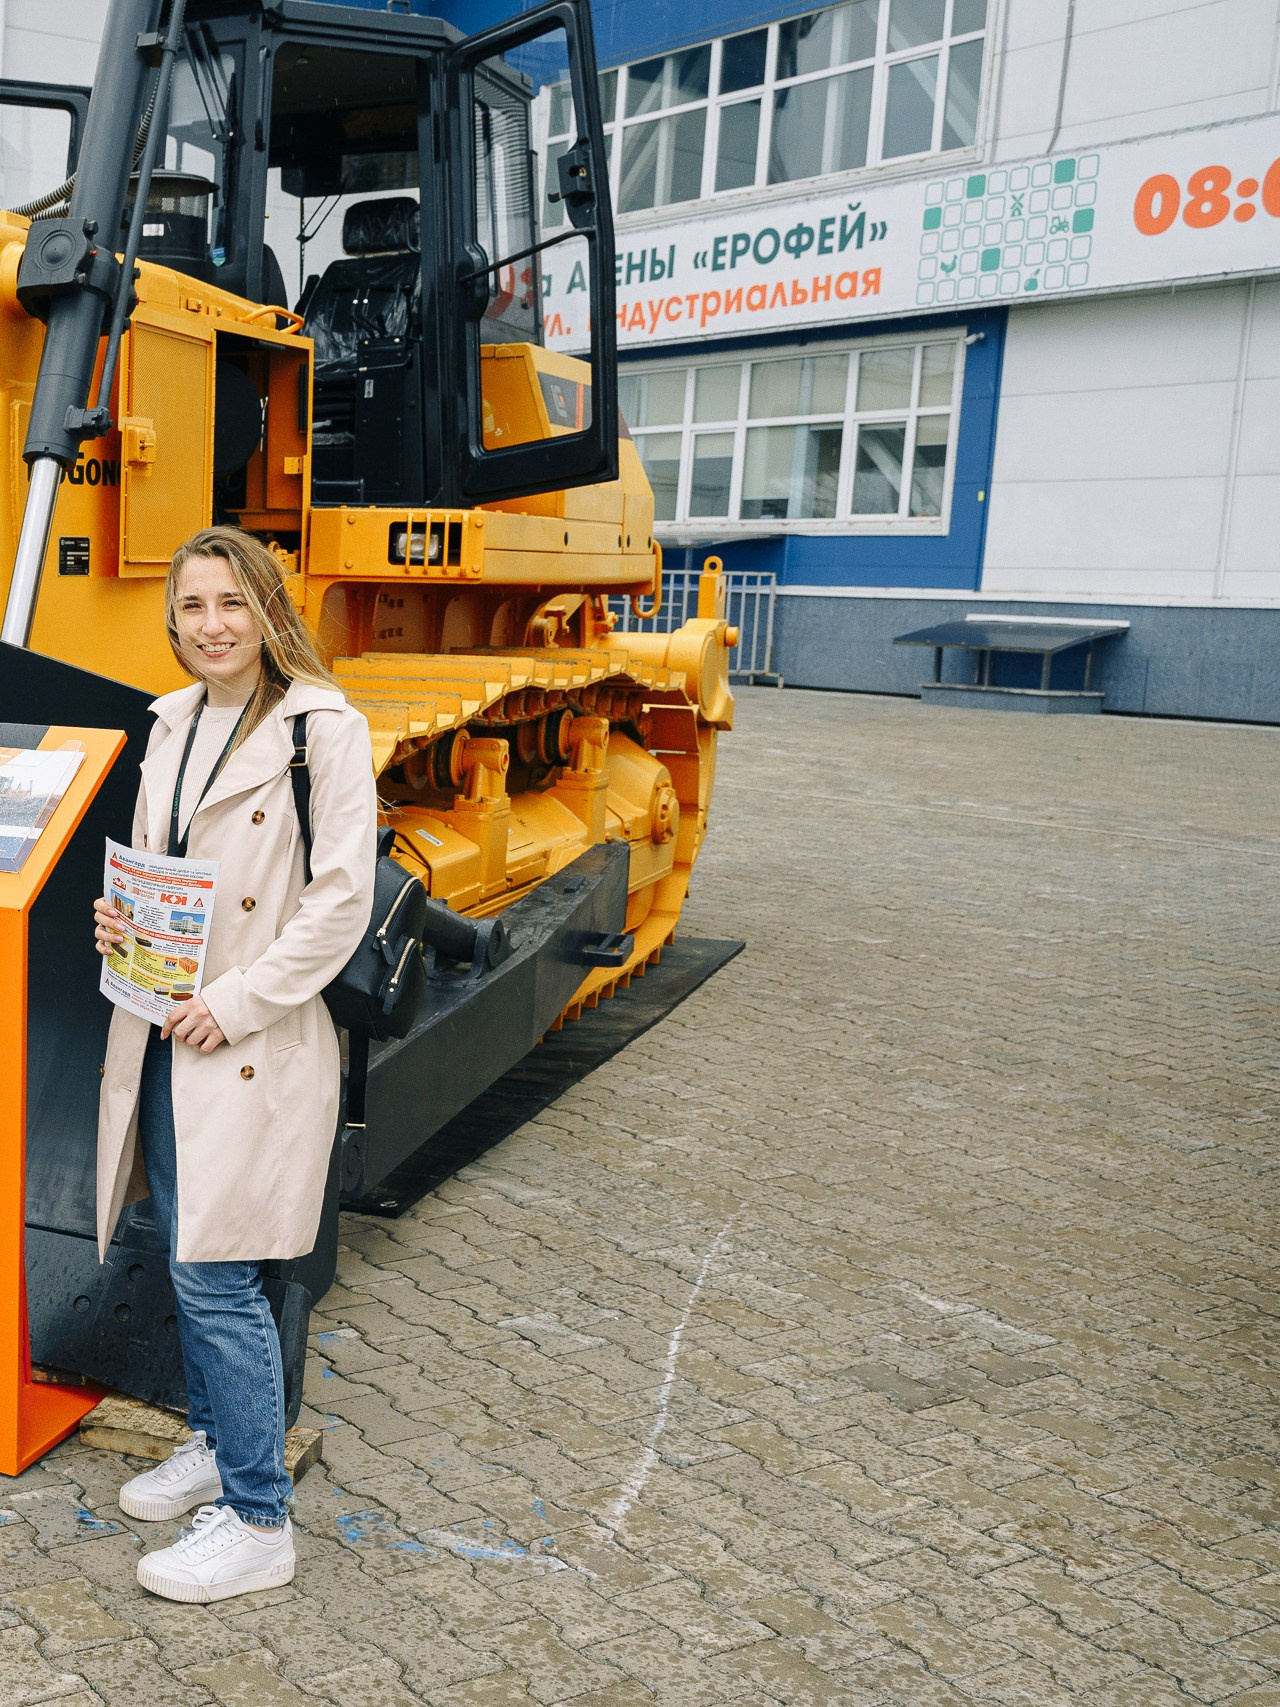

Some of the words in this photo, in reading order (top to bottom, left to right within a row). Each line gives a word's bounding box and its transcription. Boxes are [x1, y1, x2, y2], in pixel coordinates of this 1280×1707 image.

[566, 242, 676, 294] АЕНЫ
[692, 203, 888, 273] «ЕРОФЕЙ»
[588, 268, 881, 336] ндустриальная
